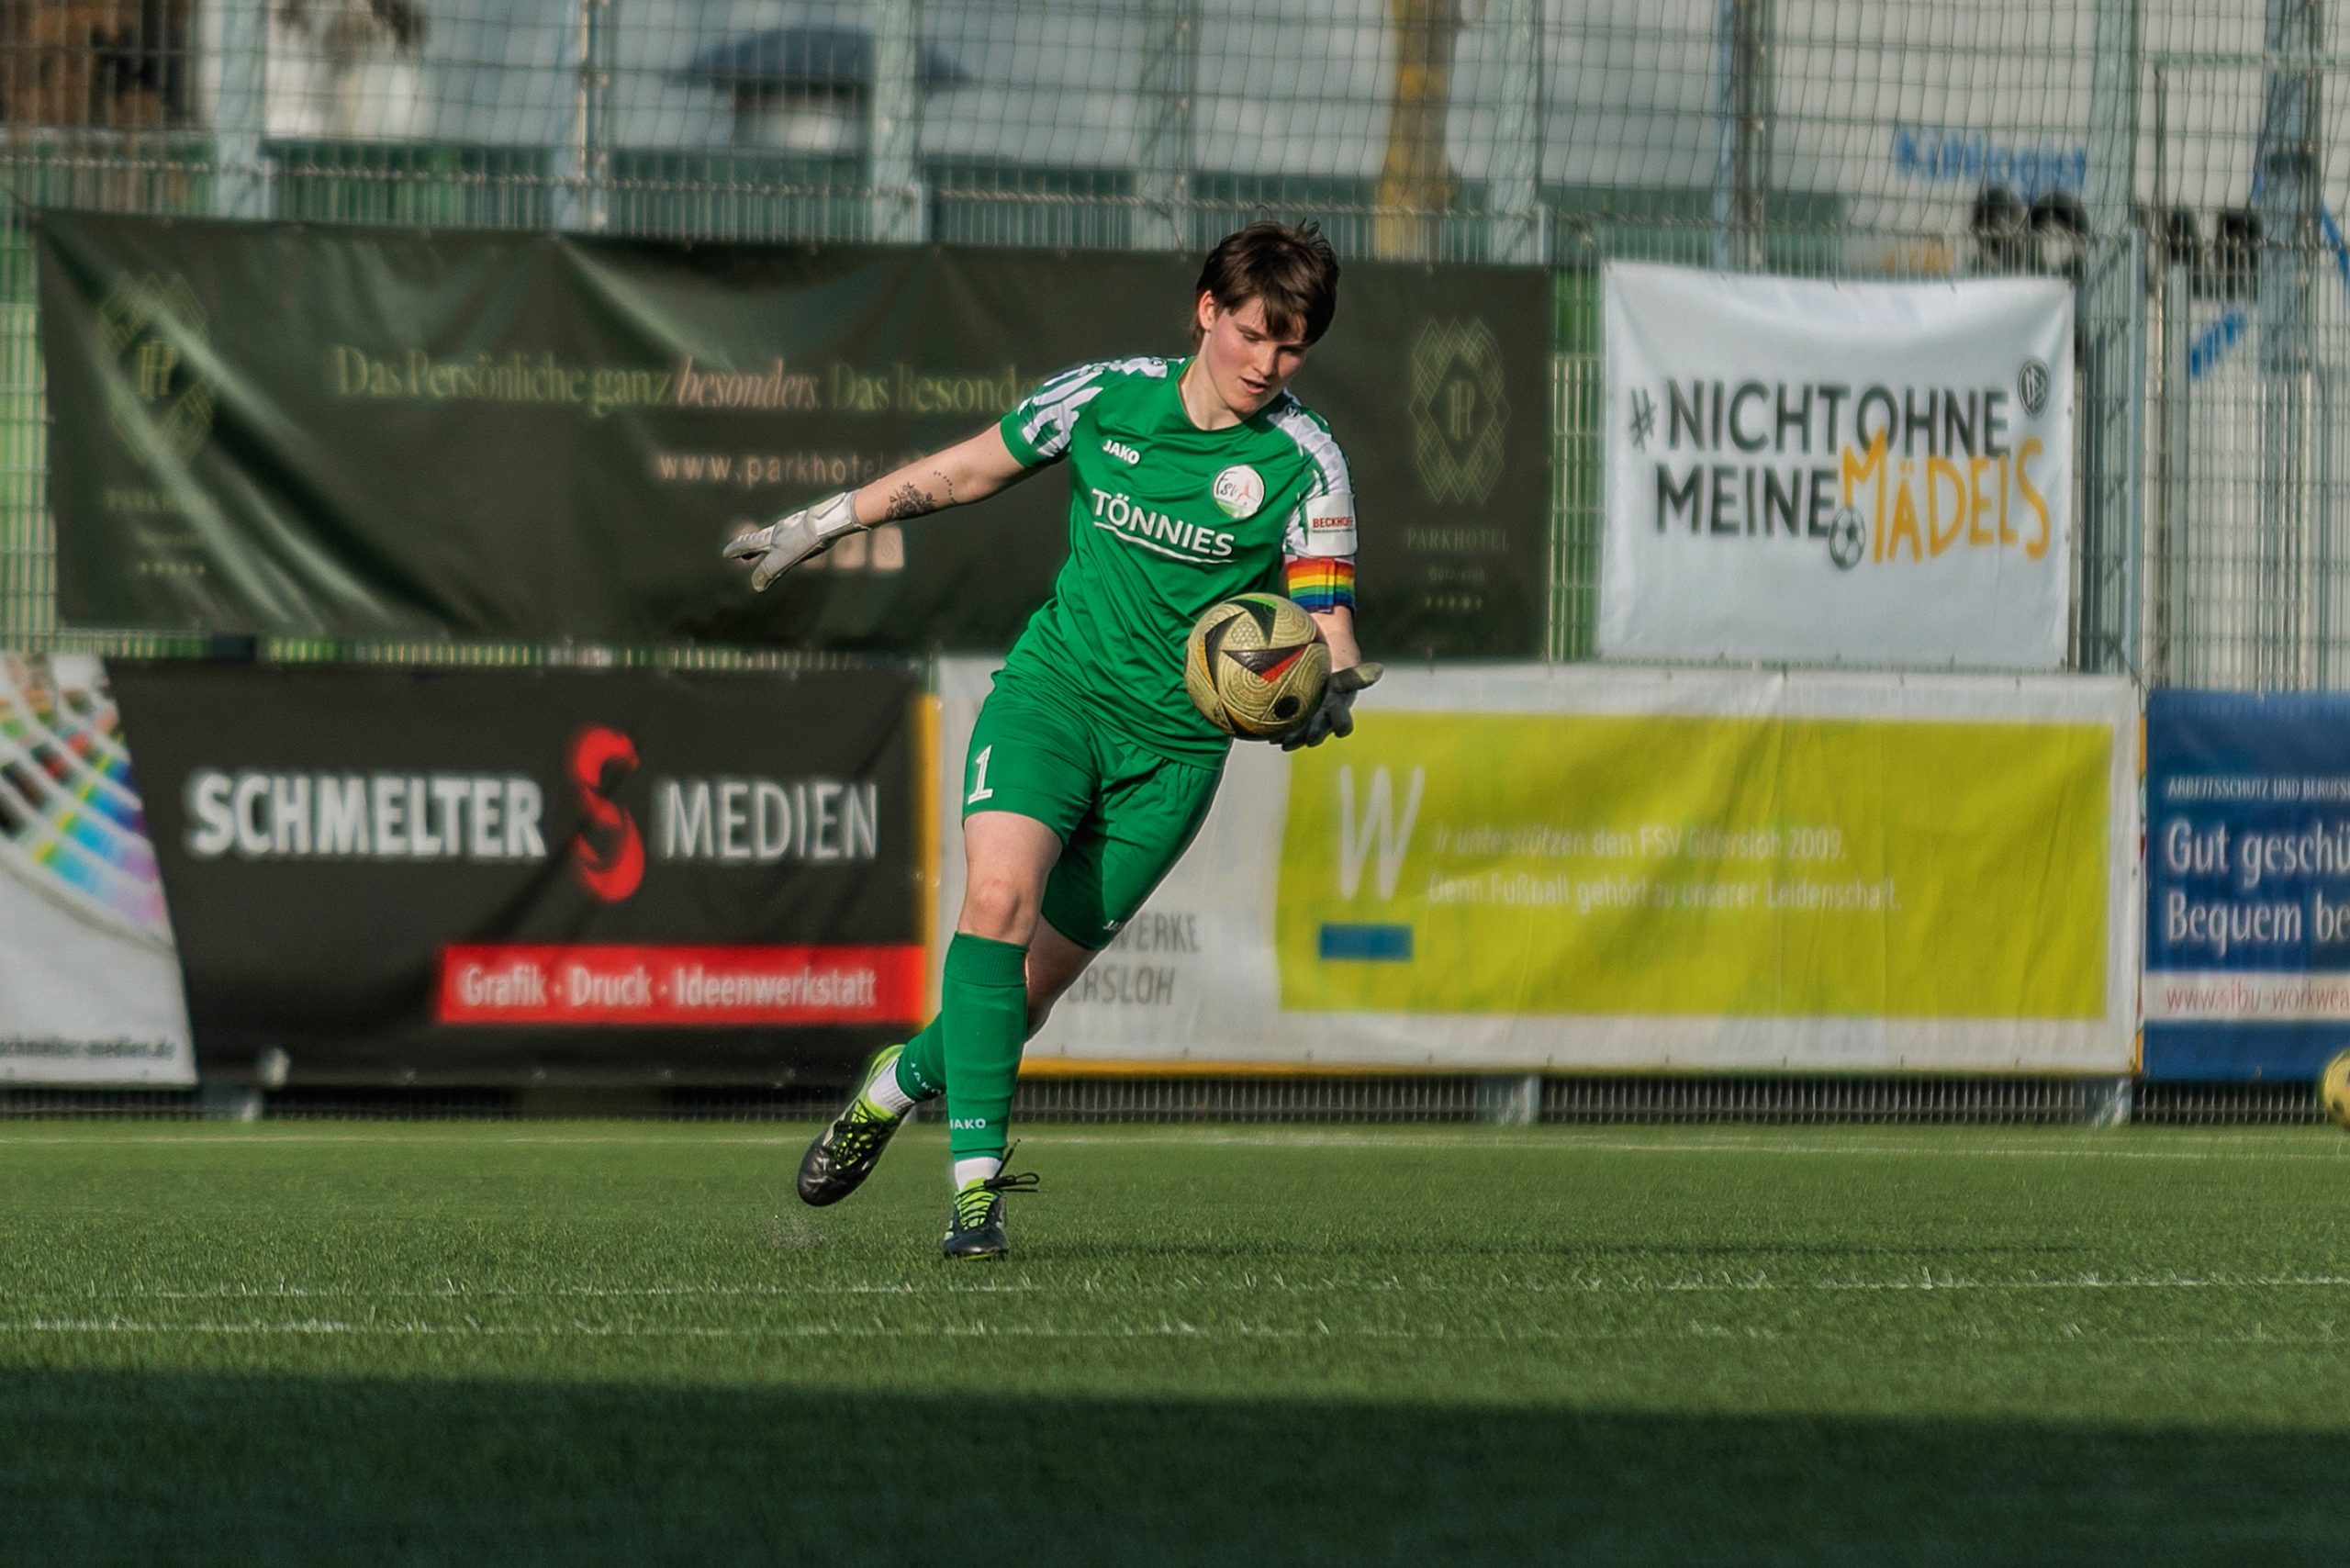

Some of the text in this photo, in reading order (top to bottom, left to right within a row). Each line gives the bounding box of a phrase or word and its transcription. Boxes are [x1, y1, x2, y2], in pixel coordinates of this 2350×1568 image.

[591, 367, 672, 419] ganz
[832, 362, 890, 411] Das
[1102, 439, 1140, 465] JAKO
[1091, 487, 1236, 557] TÖNNIES
[1656, 425, 2052, 566] MEINE MÄDELS
[968, 745, 993, 805] 1
[2273, 778, 2300, 800] UND
[2302, 778, 2350, 801] BERUFS
[190, 773, 547, 860] SCHMELTER
[661, 779, 878, 861] MEDIEN
[1592, 825, 1634, 857] den
[1639, 824, 1681, 859] FSV
[2166, 818, 2230, 875] Gut
[1489, 870, 1570, 906] Fußball
[2166, 889, 2302, 957] Bequem
[460, 963, 878, 1010] Grafik Druck Ideenwerkstatt
